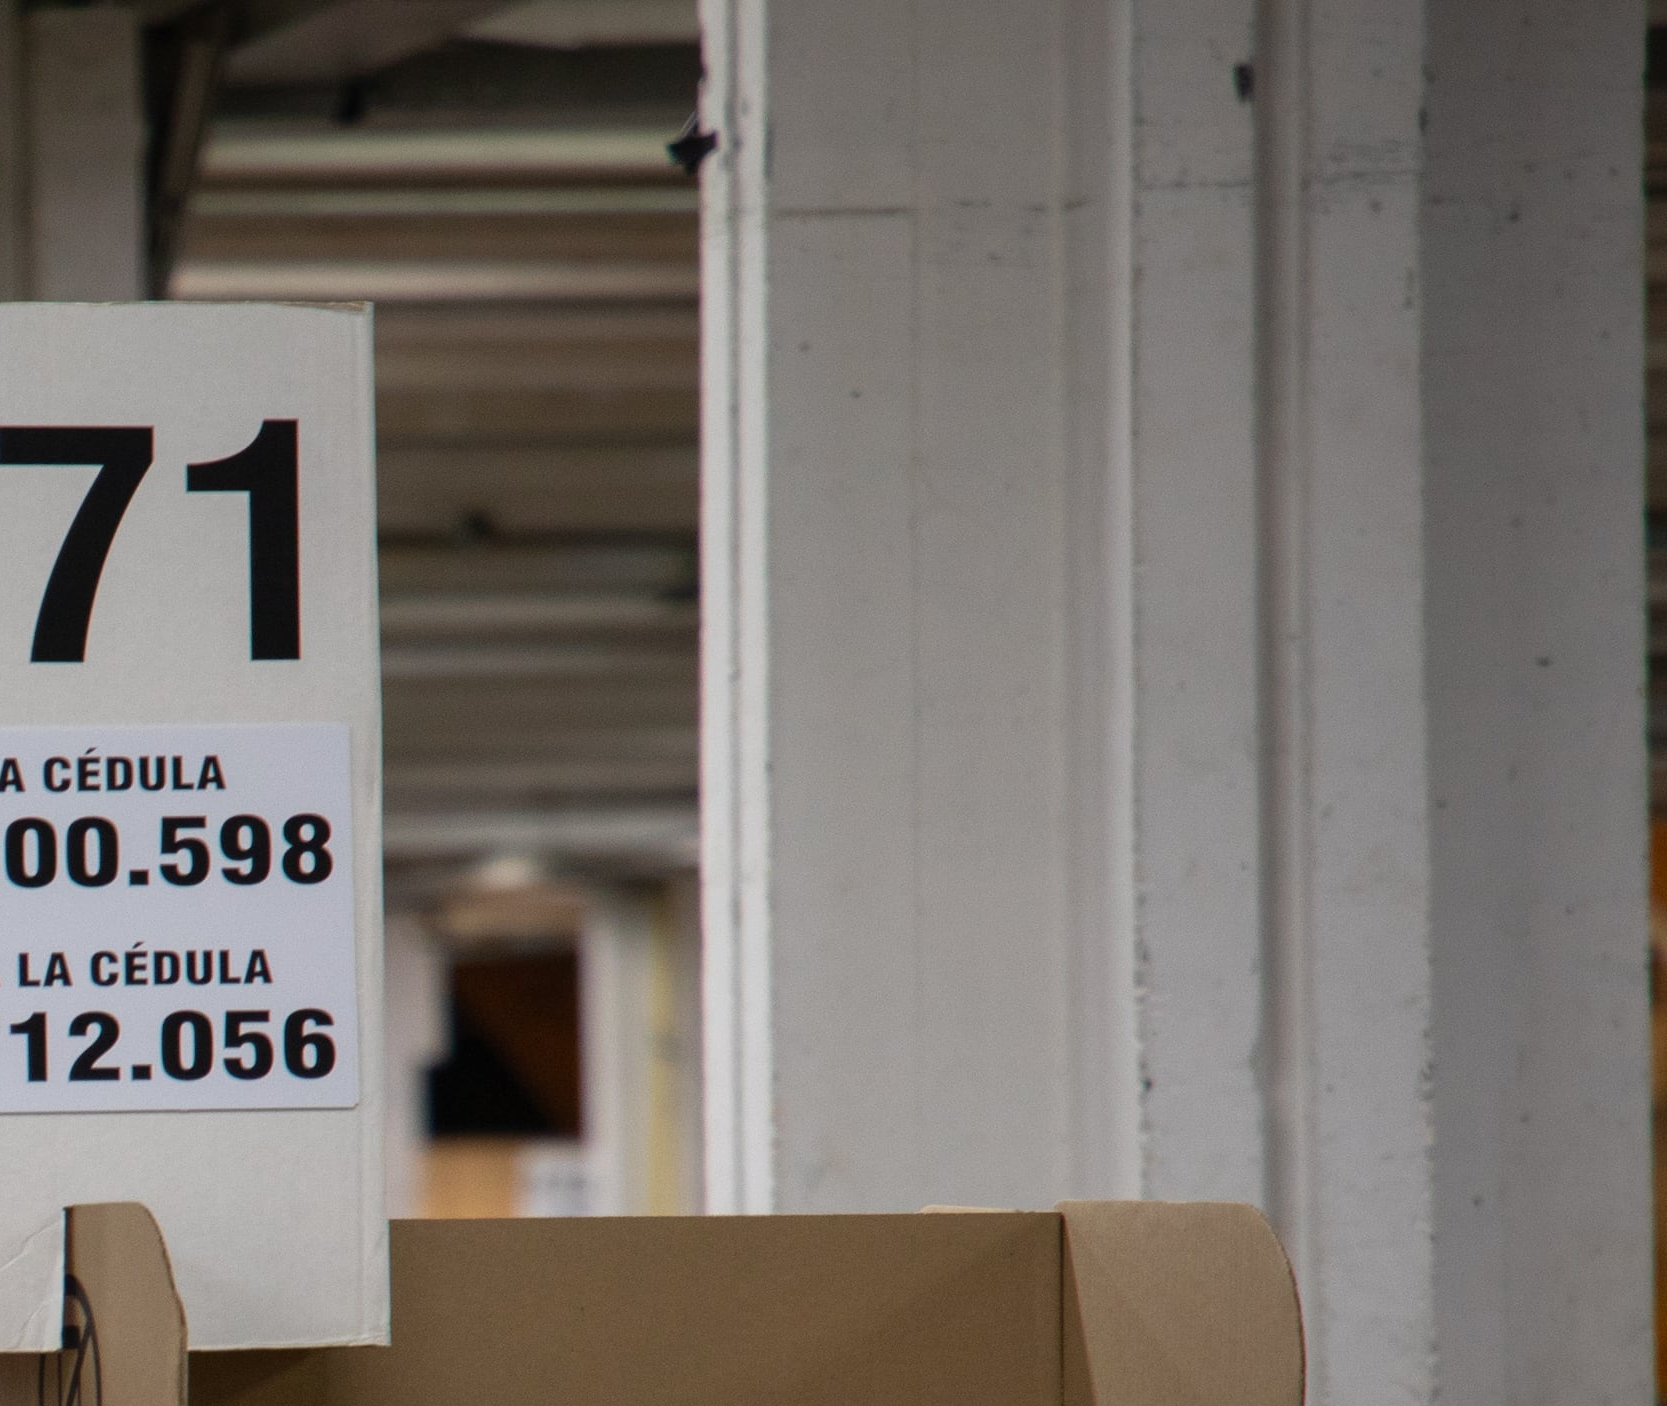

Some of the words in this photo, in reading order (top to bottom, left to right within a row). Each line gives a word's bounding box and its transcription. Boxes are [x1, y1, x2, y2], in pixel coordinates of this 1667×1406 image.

[42, 747, 226, 793] CÉDULA
[18, 952, 72, 988] LA
[89, 941, 273, 987] CÉDULA
